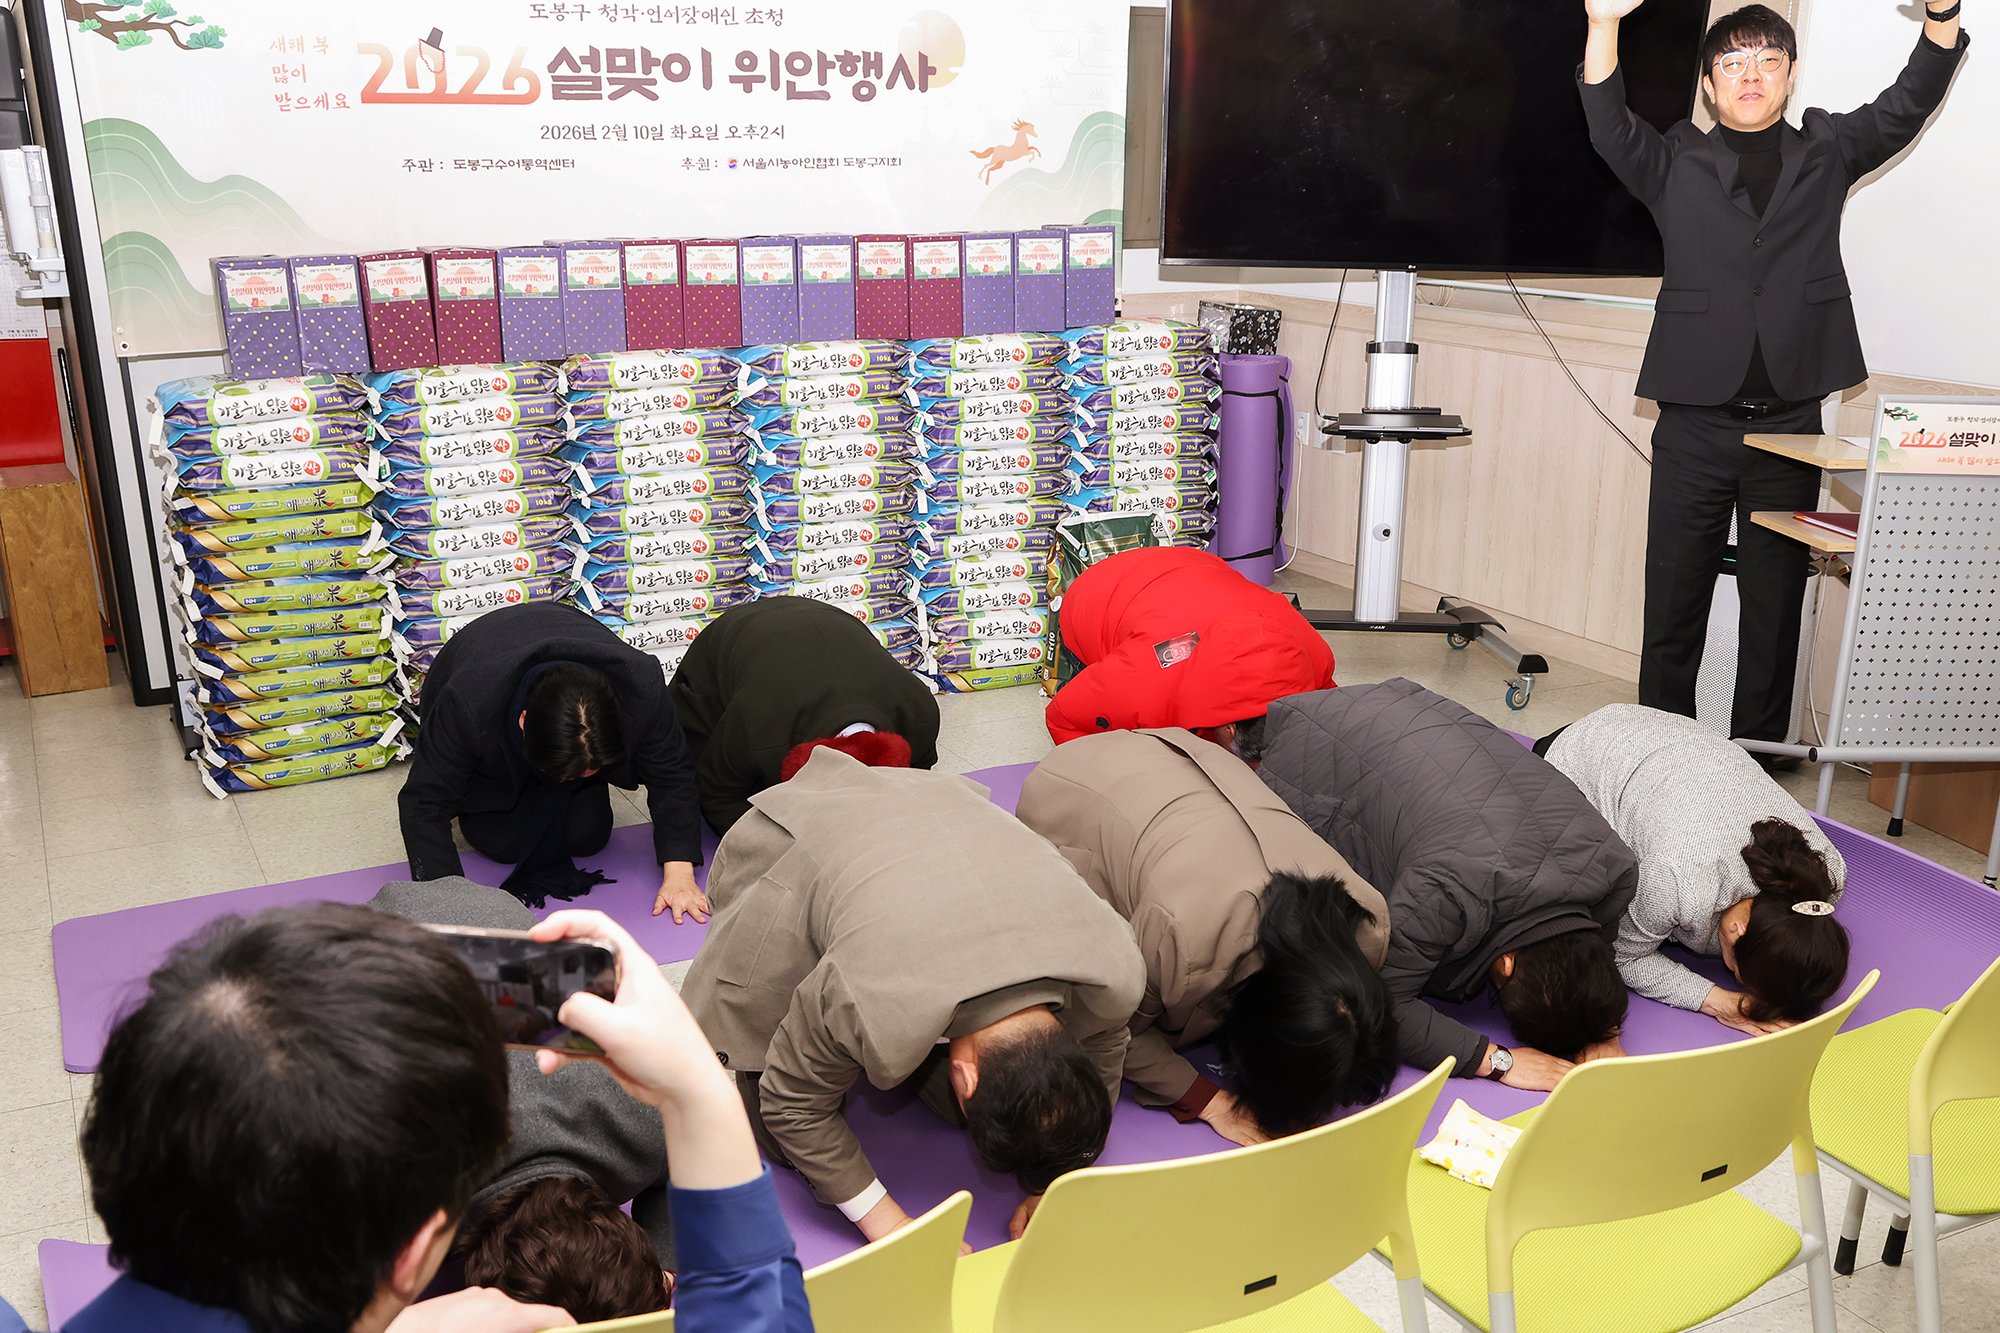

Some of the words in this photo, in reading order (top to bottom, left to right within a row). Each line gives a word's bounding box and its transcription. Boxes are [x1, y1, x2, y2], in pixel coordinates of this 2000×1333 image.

[529, 2, 591, 22] 도봉구
[598, 3, 739, 26] 청각·언어장애인
[744, 7, 784, 27] 초청
[269, 34, 305, 54] 새해
[312, 35, 330, 55] 복
[271, 63, 307, 84] 많이
[356, 42, 541, 105] 2026
[547, 45, 713, 101] 설맞이
[728, 48, 937, 102] 위안행사
[274, 92, 351, 112] 받으세요
[540, 124, 597, 141] 2026년
[602, 123, 628, 142] 2월
[632, 123, 664, 141] 10일
[669, 124, 719, 141] 화요일
[402, 158, 434, 172] 주관
[453, 157, 575, 172] 도봉구수어통역센터
[742, 157, 839, 170] 서울시농아인협회
[1899, 431, 1947, 449] 2026
[1949, 432, 1996, 448] 설맞이
